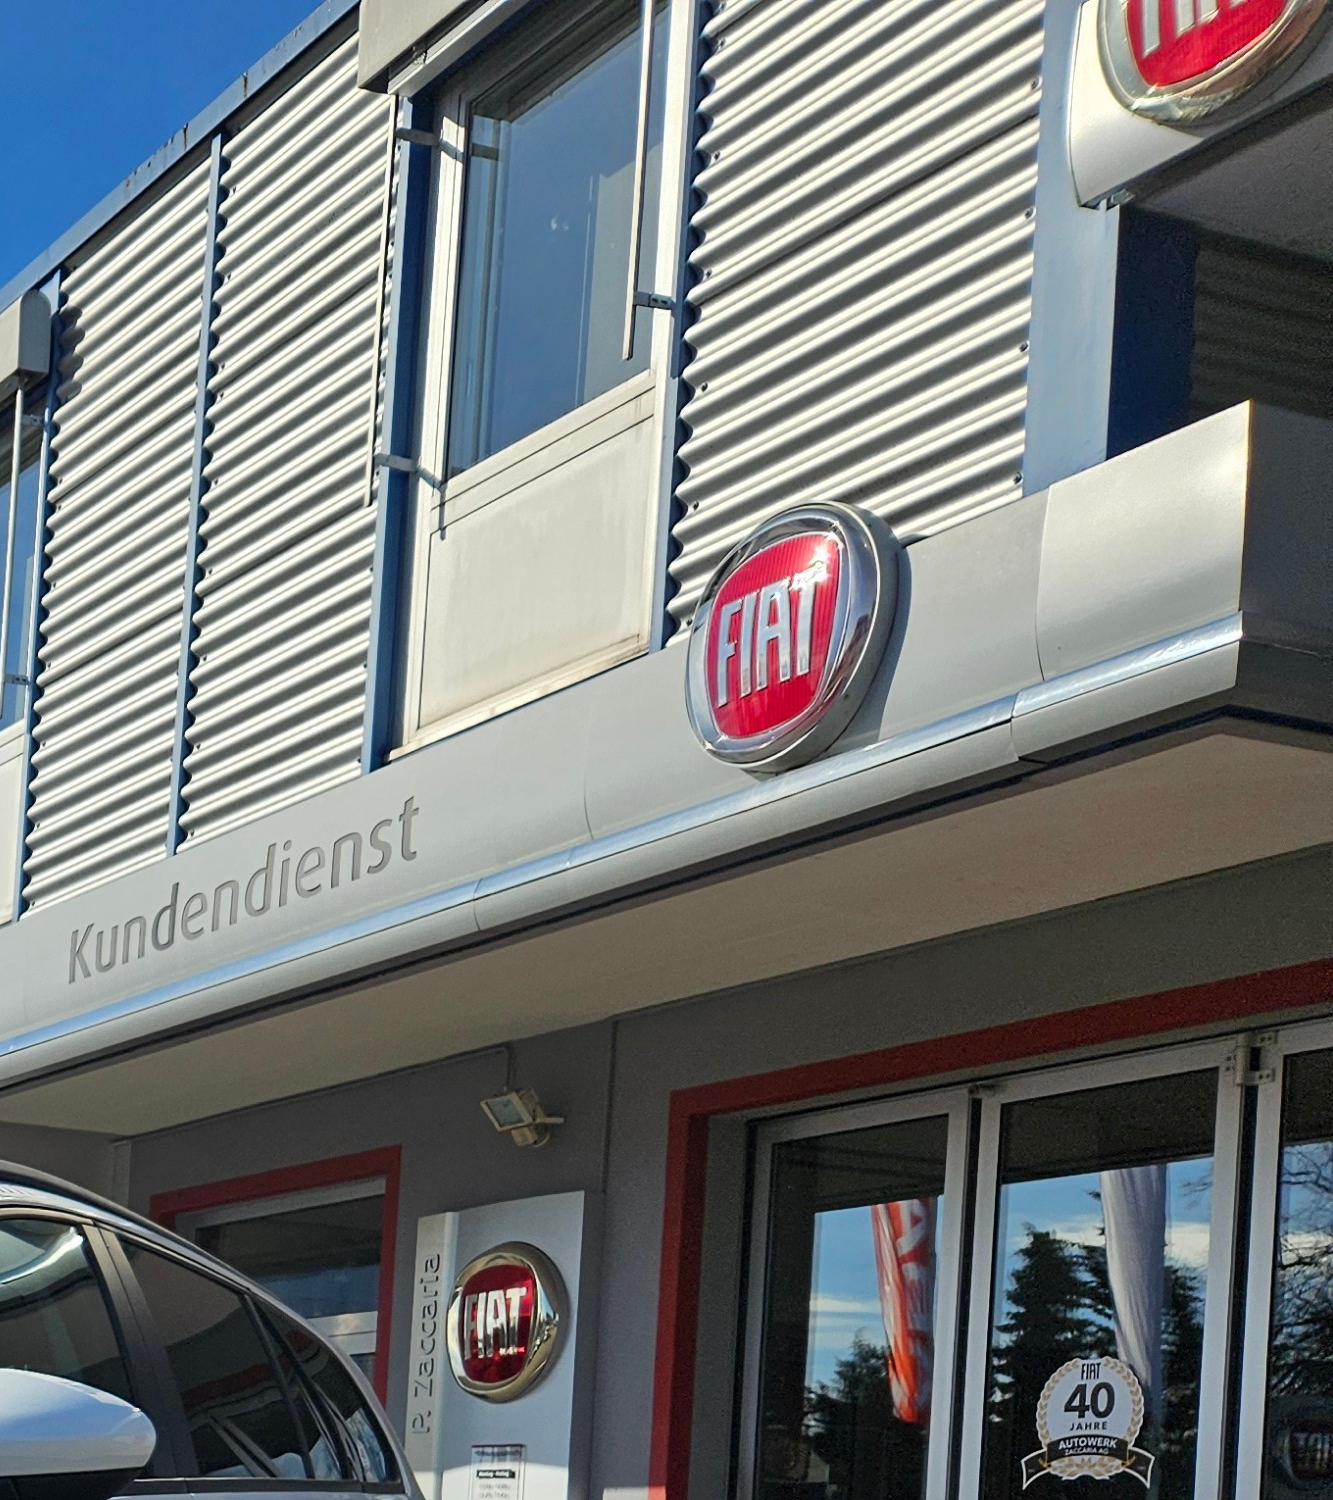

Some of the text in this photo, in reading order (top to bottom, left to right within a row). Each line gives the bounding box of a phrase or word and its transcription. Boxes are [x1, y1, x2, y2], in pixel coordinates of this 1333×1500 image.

[717, 560, 827, 708] FIAT
[68, 795, 420, 984] Kundendienst
[414, 1253, 440, 1397] Zaccaria
[464, 1287, 527, 1361] FIAT
[1081, 1362, 1101, 1380] FIAT
[1064, 1382, 1115, 1418] 40
[1058, 1437, 1117, 1450] AUTOWERK
[1069, 1422, 1108, 1431] JAHRE
[1065, 1447, 1097, 1455] ZACCARIA
